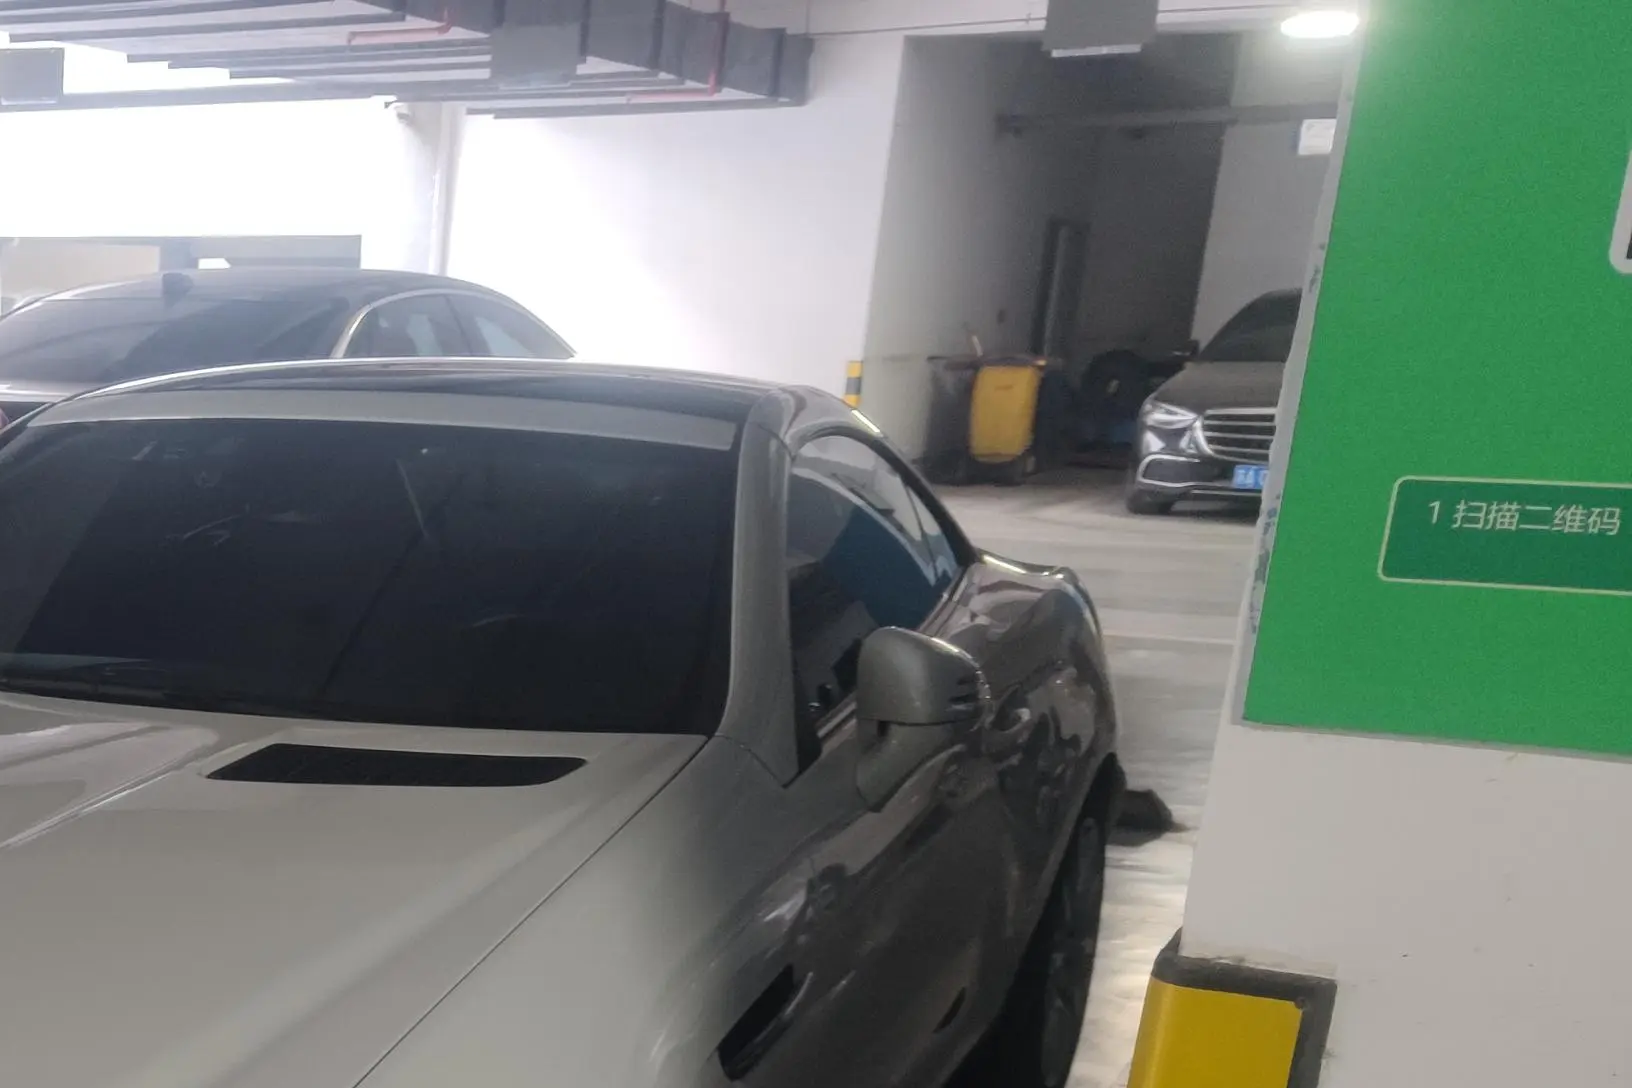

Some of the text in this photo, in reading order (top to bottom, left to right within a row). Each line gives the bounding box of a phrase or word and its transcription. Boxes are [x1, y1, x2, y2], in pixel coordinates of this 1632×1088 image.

[1428, 499, 1621, 536] 1 扫描二维码
